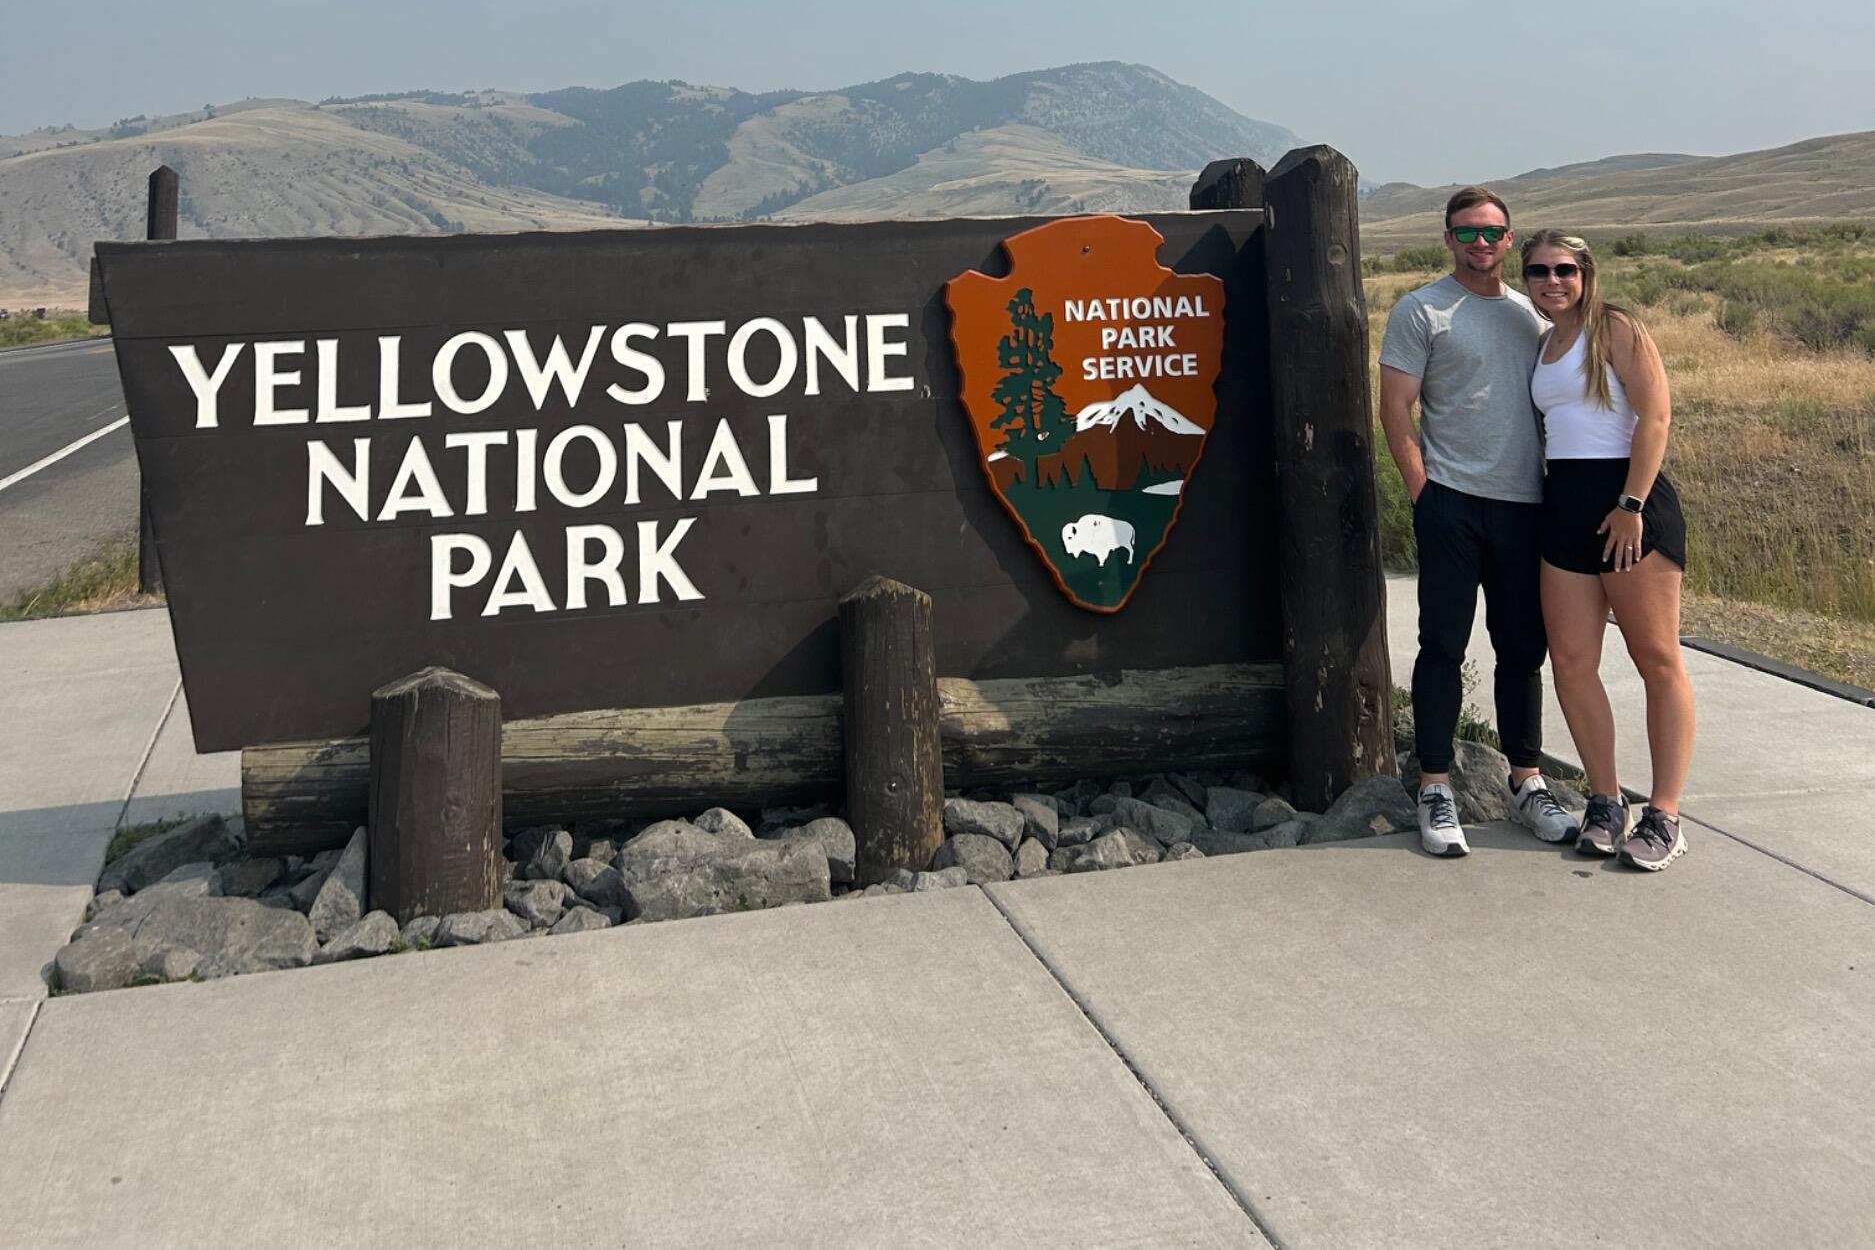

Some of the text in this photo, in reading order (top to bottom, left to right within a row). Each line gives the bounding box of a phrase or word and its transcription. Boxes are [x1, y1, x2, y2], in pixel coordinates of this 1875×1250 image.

[1064, 295, 1210, 322] NATIONAL
[1101, 325, 1176, 350] PARK
[168, 313, 915, 429] YELLOWSTONE
[1082, 352, 1198, 381] SERVICE
[305, 414, 818, 526] NATIONAL
[430, 517, 706, 621] PARK
